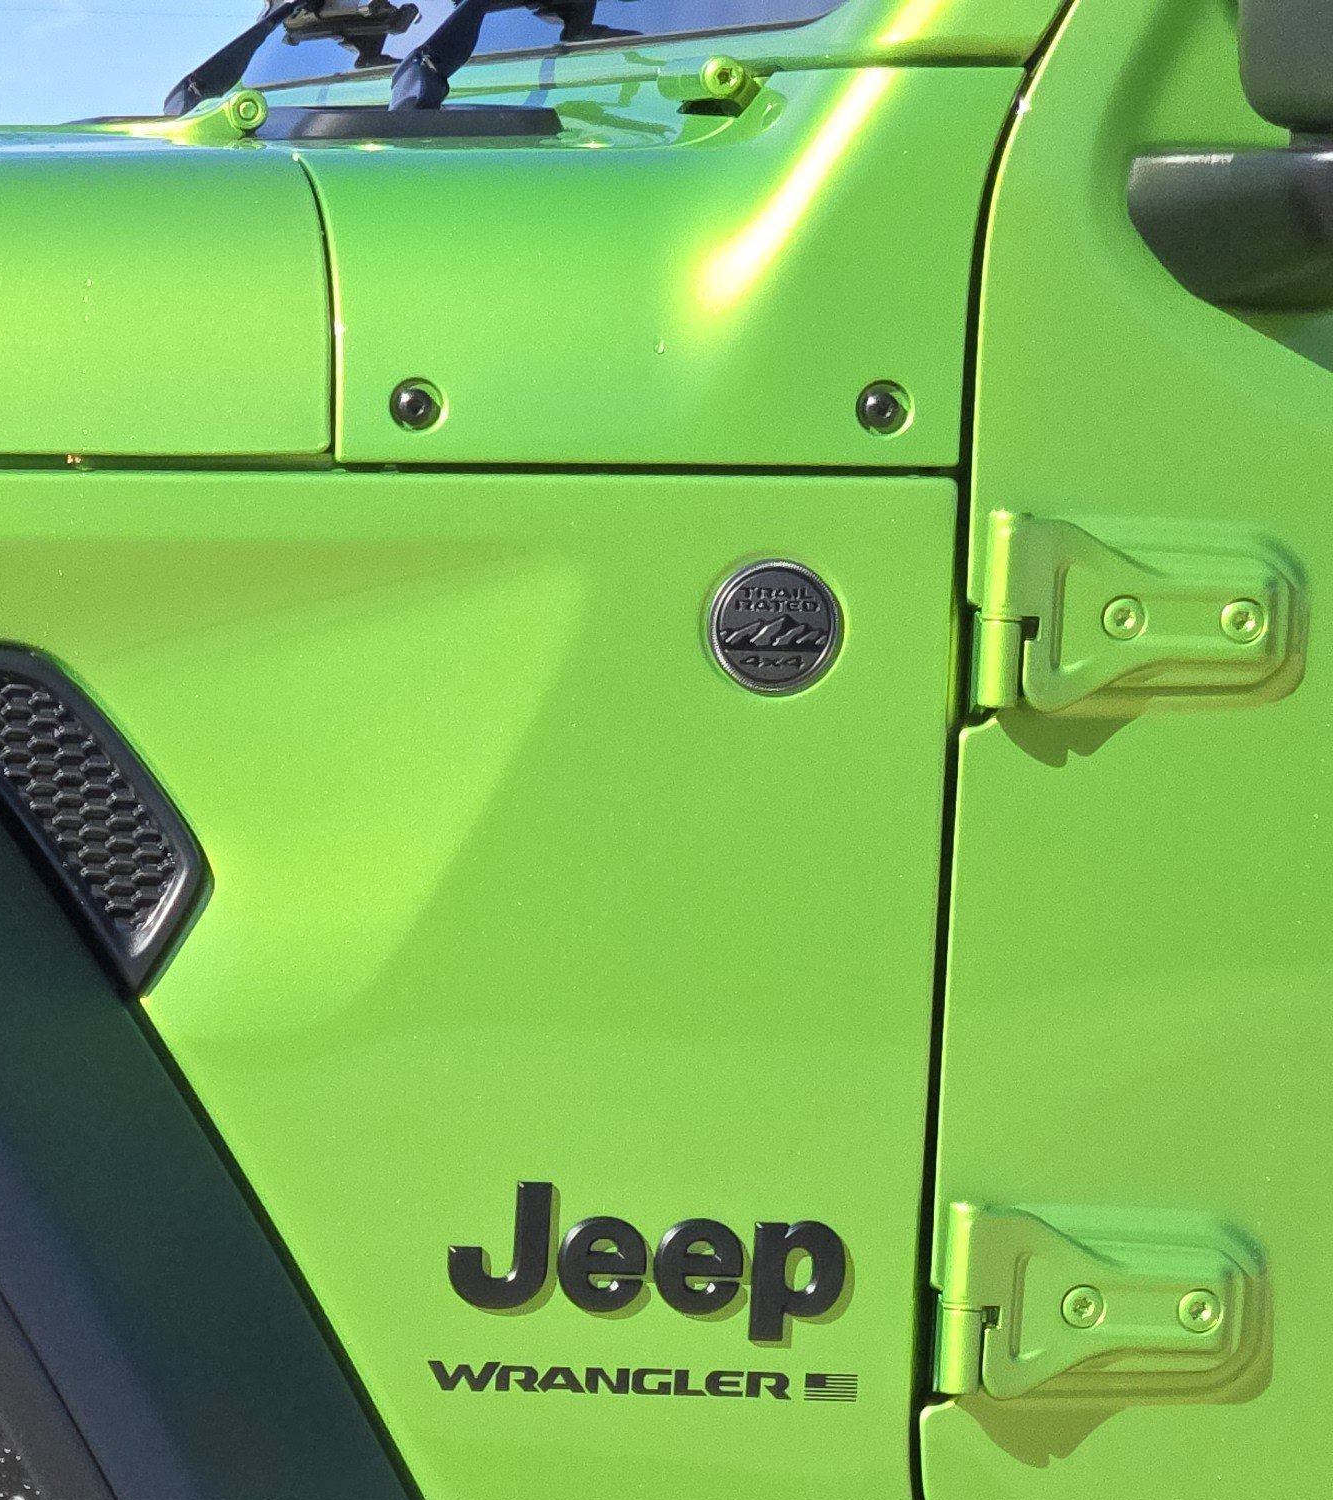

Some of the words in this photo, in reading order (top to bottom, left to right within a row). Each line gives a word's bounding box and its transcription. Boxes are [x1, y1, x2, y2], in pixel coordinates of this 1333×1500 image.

[735, 600, 821, 612] RATED
[741, 587, 814, 600] TRAIL
[447, 1181, 847, 1342] Jeep
[427, 1360, 792, 1399] WRANGLER
